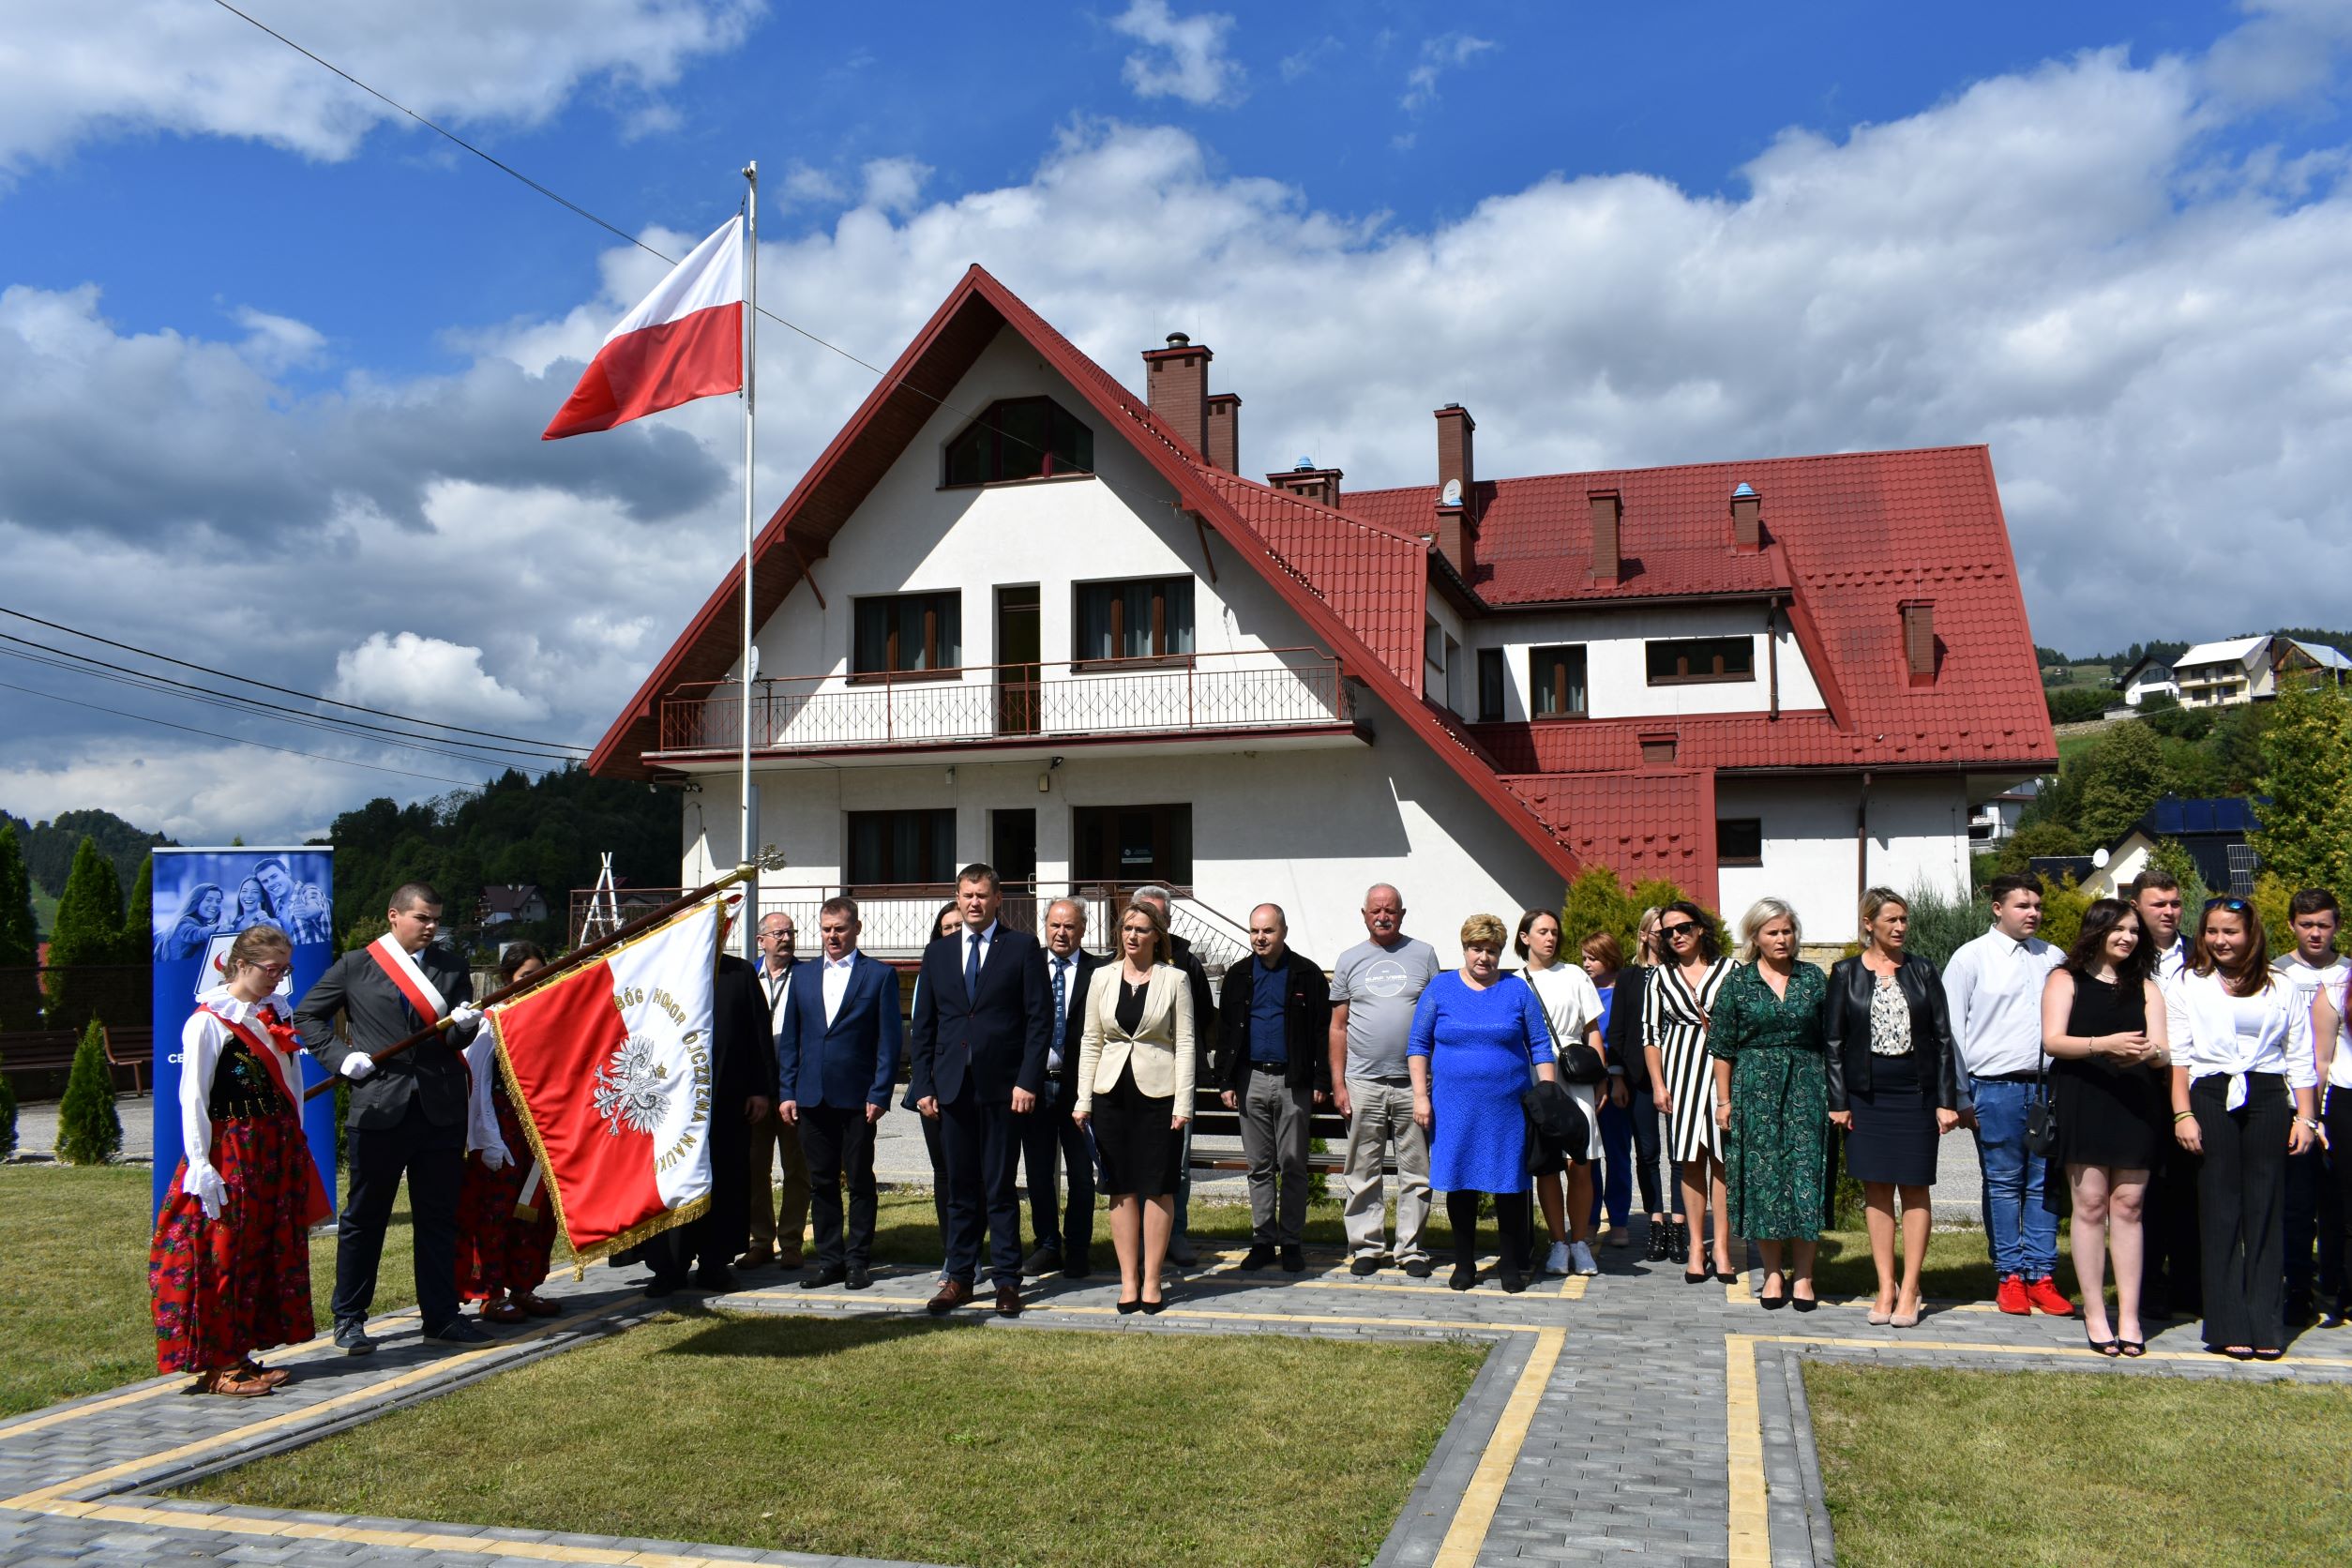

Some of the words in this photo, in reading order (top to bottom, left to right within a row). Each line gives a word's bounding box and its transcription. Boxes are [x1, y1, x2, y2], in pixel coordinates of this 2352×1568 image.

[613, 987, 643, 1011] BÓG
[653, 988, 686, 1027] HONOR
[682, 1032, 711, 1123] OJCZYZNA
